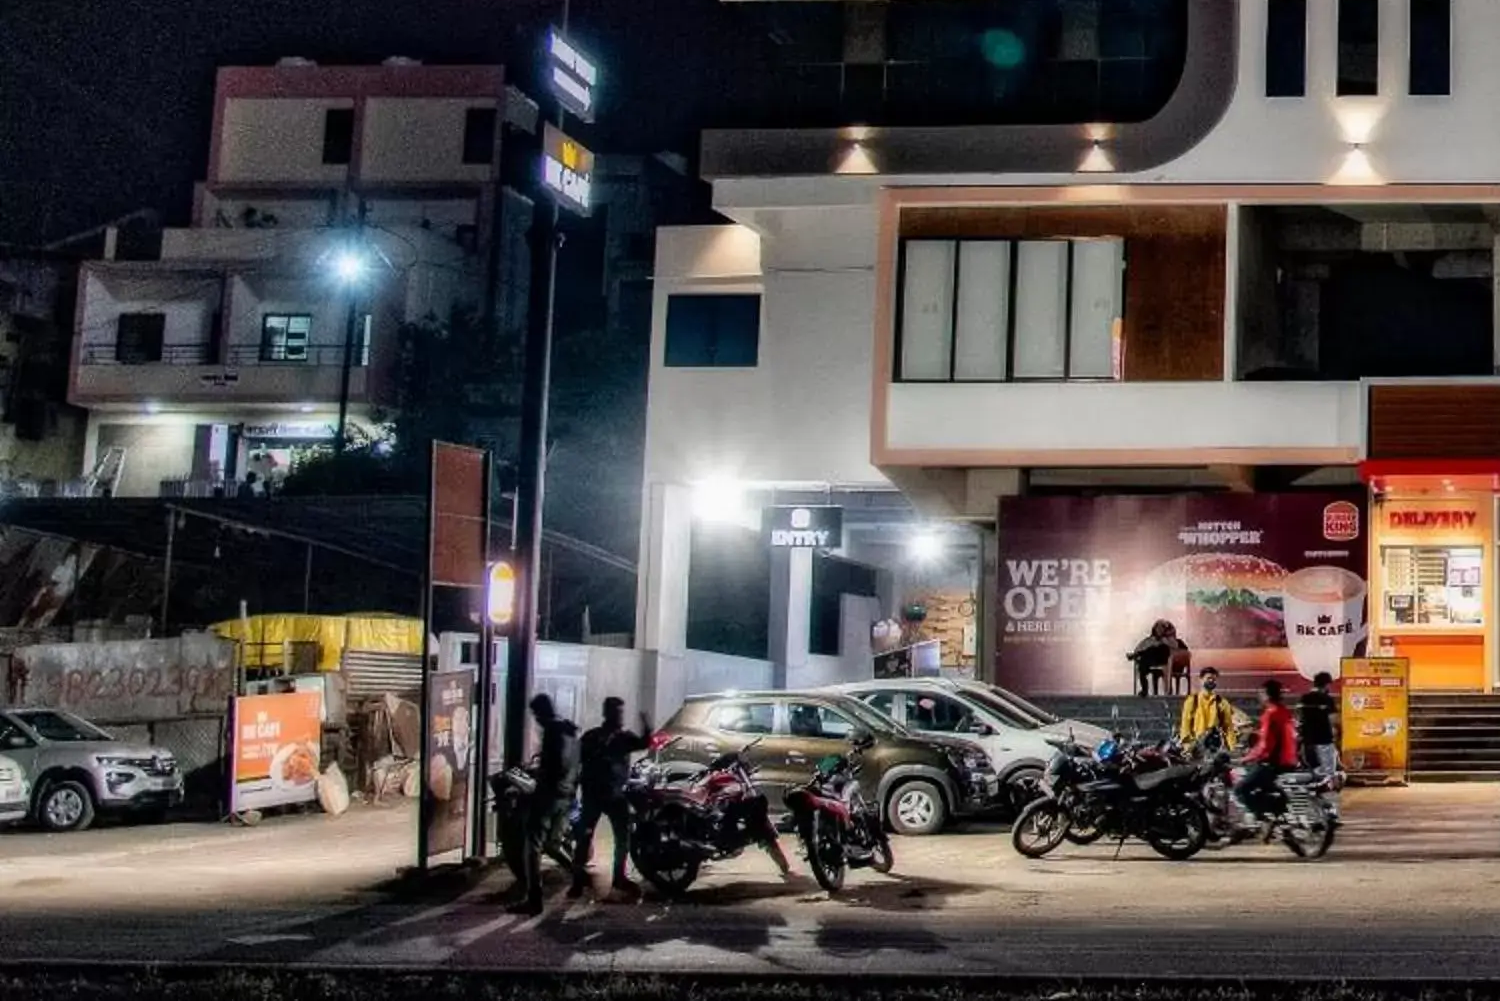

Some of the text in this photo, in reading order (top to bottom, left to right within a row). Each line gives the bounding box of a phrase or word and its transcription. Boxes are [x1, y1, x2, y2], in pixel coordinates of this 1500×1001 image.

[1326, 520, 1357, 533] KING
[1390, 510, 1477, 529] DELIVERY
[771, 530, 829, 547] ENTRY
[1005, 559, 1112, 587] WE'RE
[1017, 621, 1052, 633] HERE
[1296, 618, 1353, 636] BK CAFÉ
